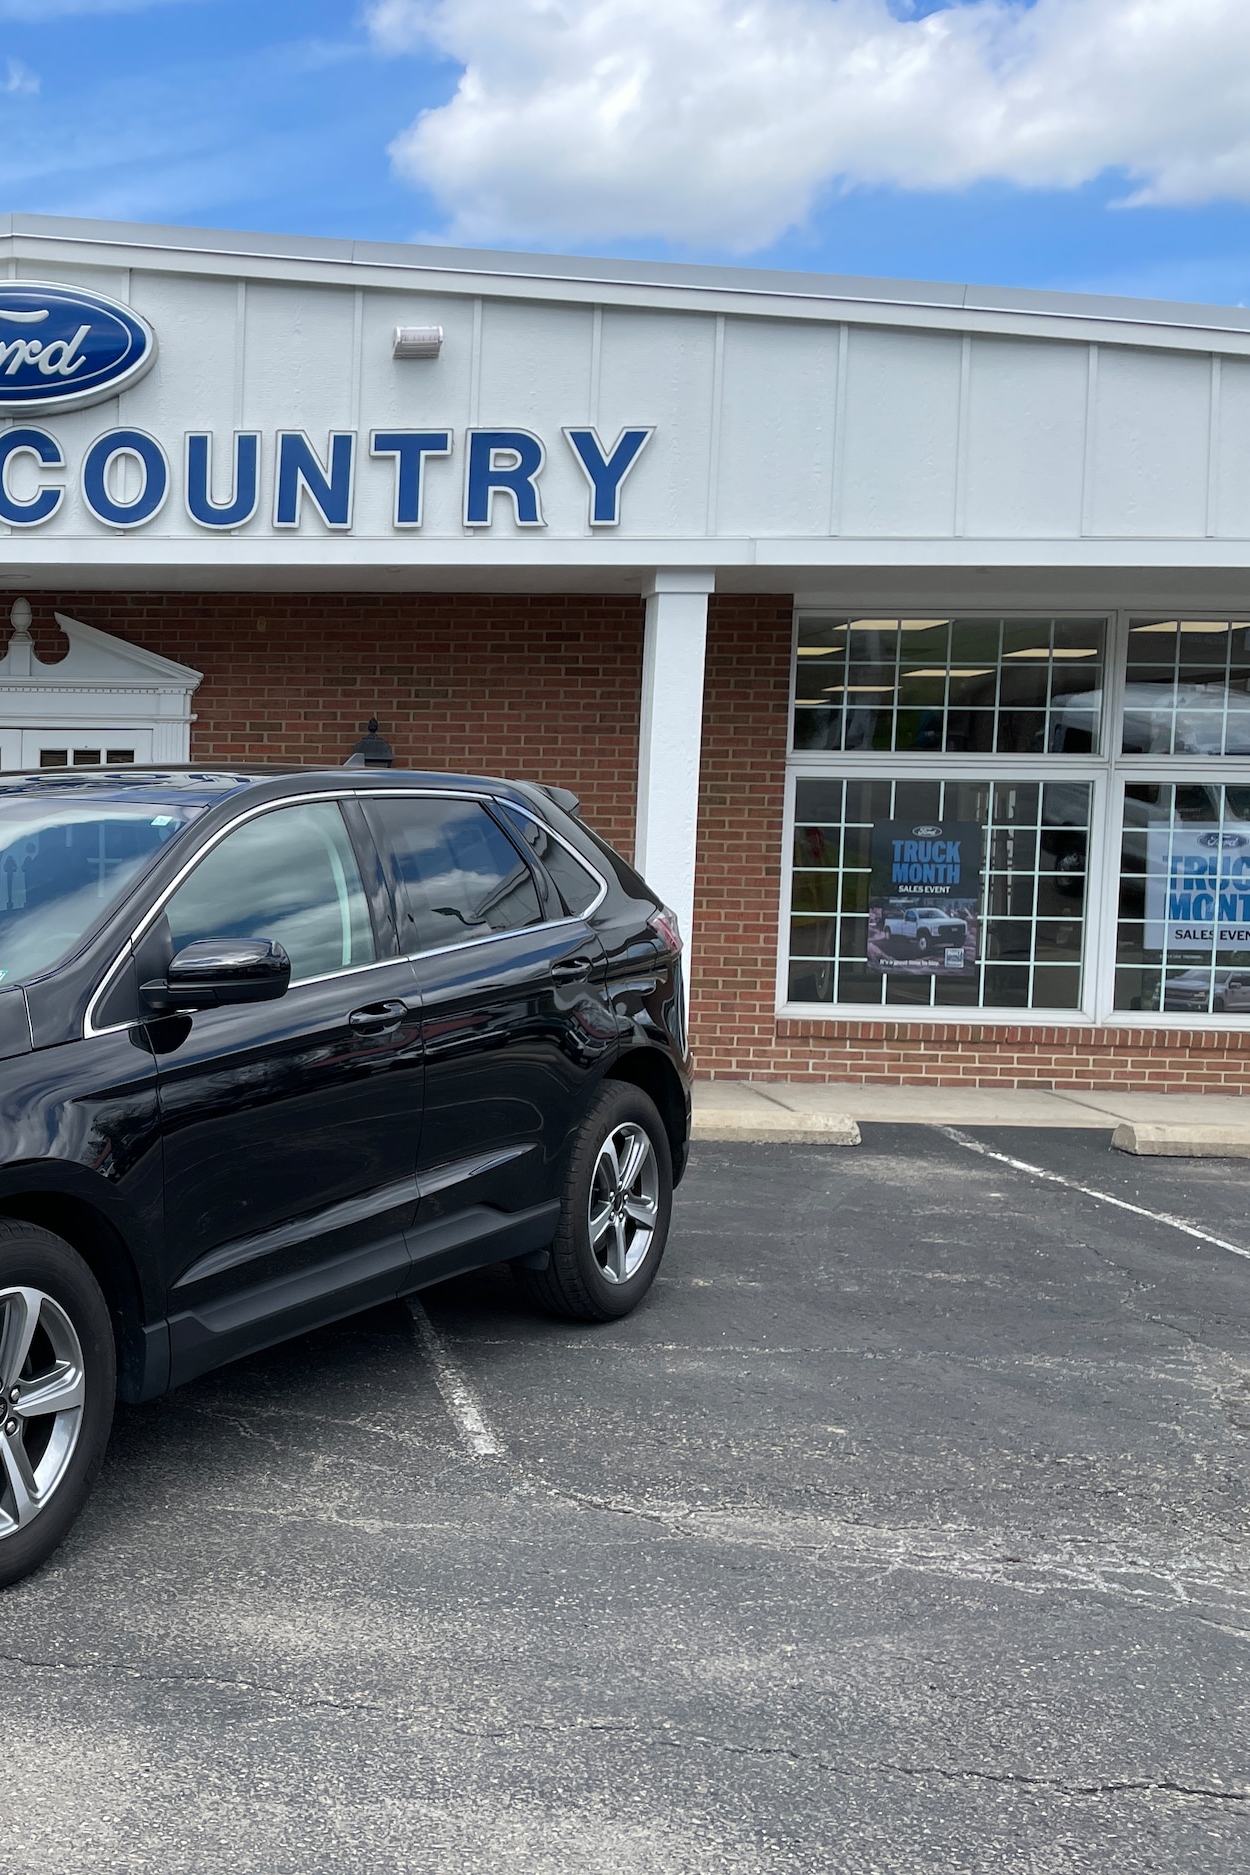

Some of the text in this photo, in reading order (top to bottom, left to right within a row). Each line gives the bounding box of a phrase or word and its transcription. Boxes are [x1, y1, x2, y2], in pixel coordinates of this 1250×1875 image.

[892, 840, 961, 863] TRUCK
[892, 863, 960, 884] MONTH
[898, 885, 951, 894] SALES EVENT
[1174, 929, 1215, 940] SALES
